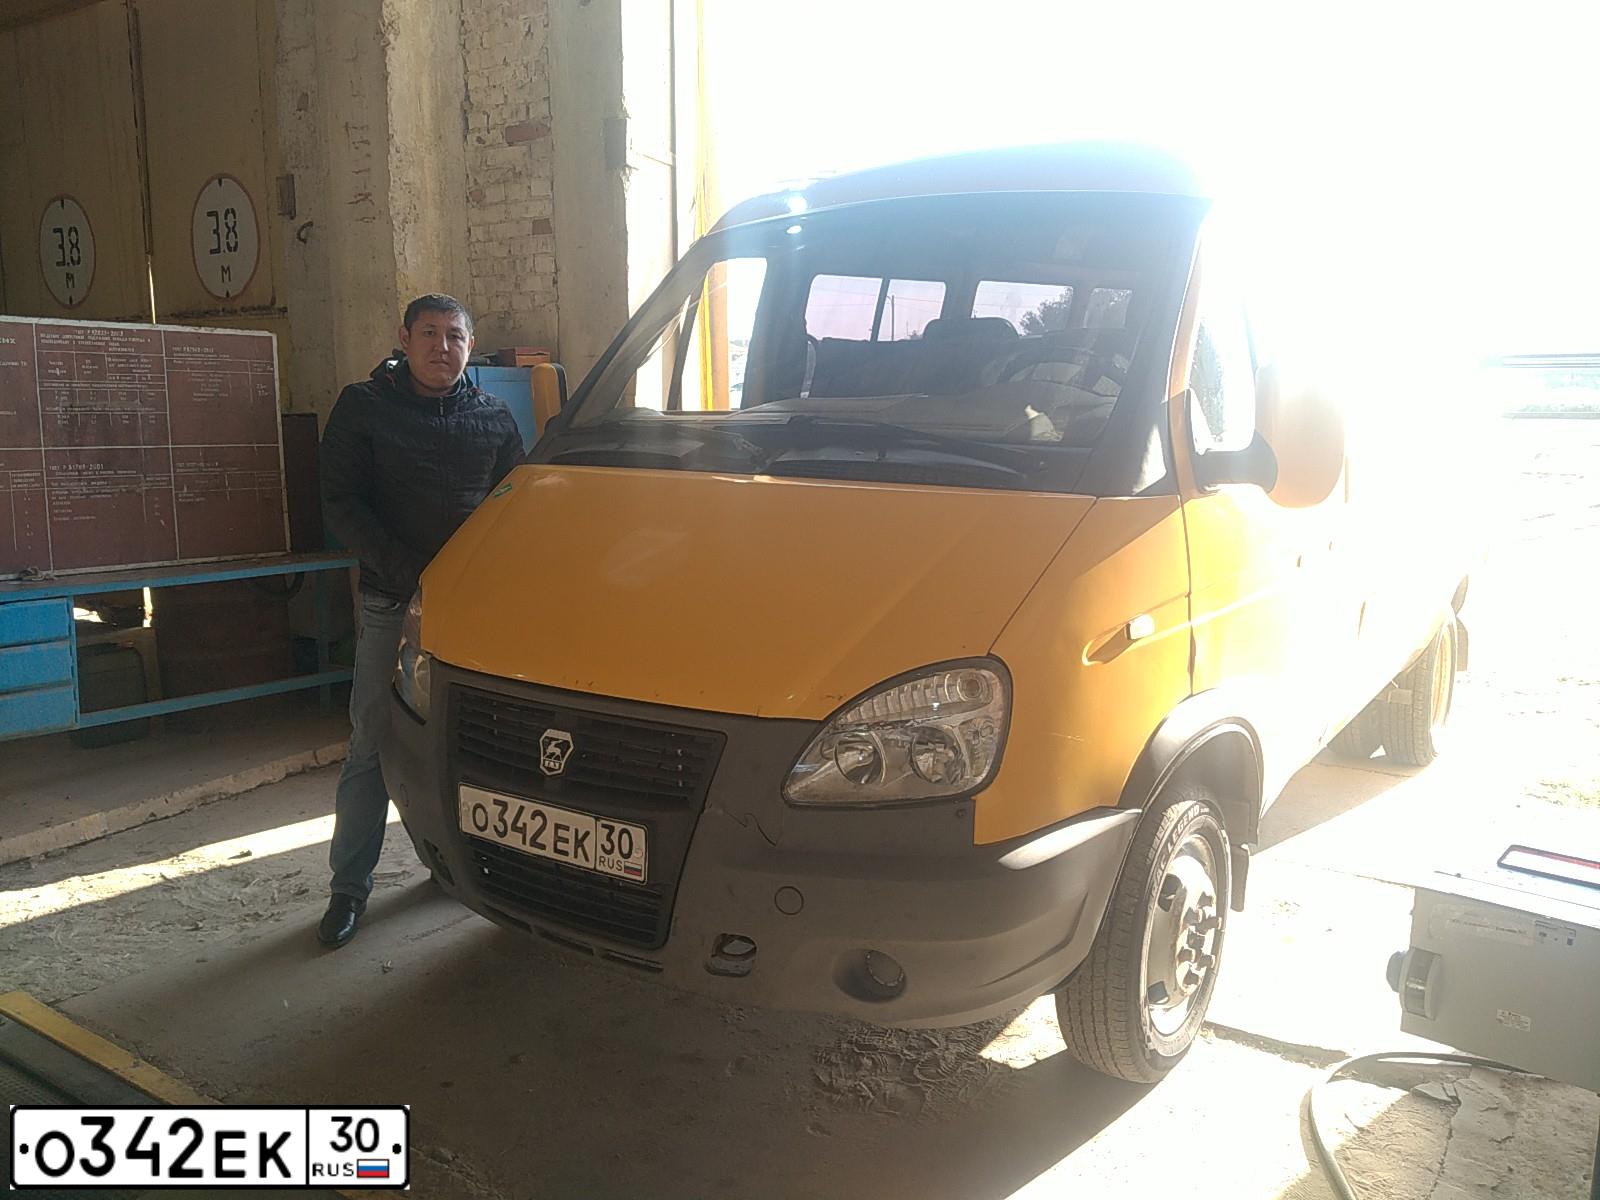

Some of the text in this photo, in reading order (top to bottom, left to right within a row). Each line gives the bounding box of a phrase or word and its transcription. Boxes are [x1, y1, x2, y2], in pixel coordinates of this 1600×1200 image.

[600, 824, 633, 859] 30
[1167, 804, 1200, 854] LEGEND
[599, 856, 623, 872] RUS
